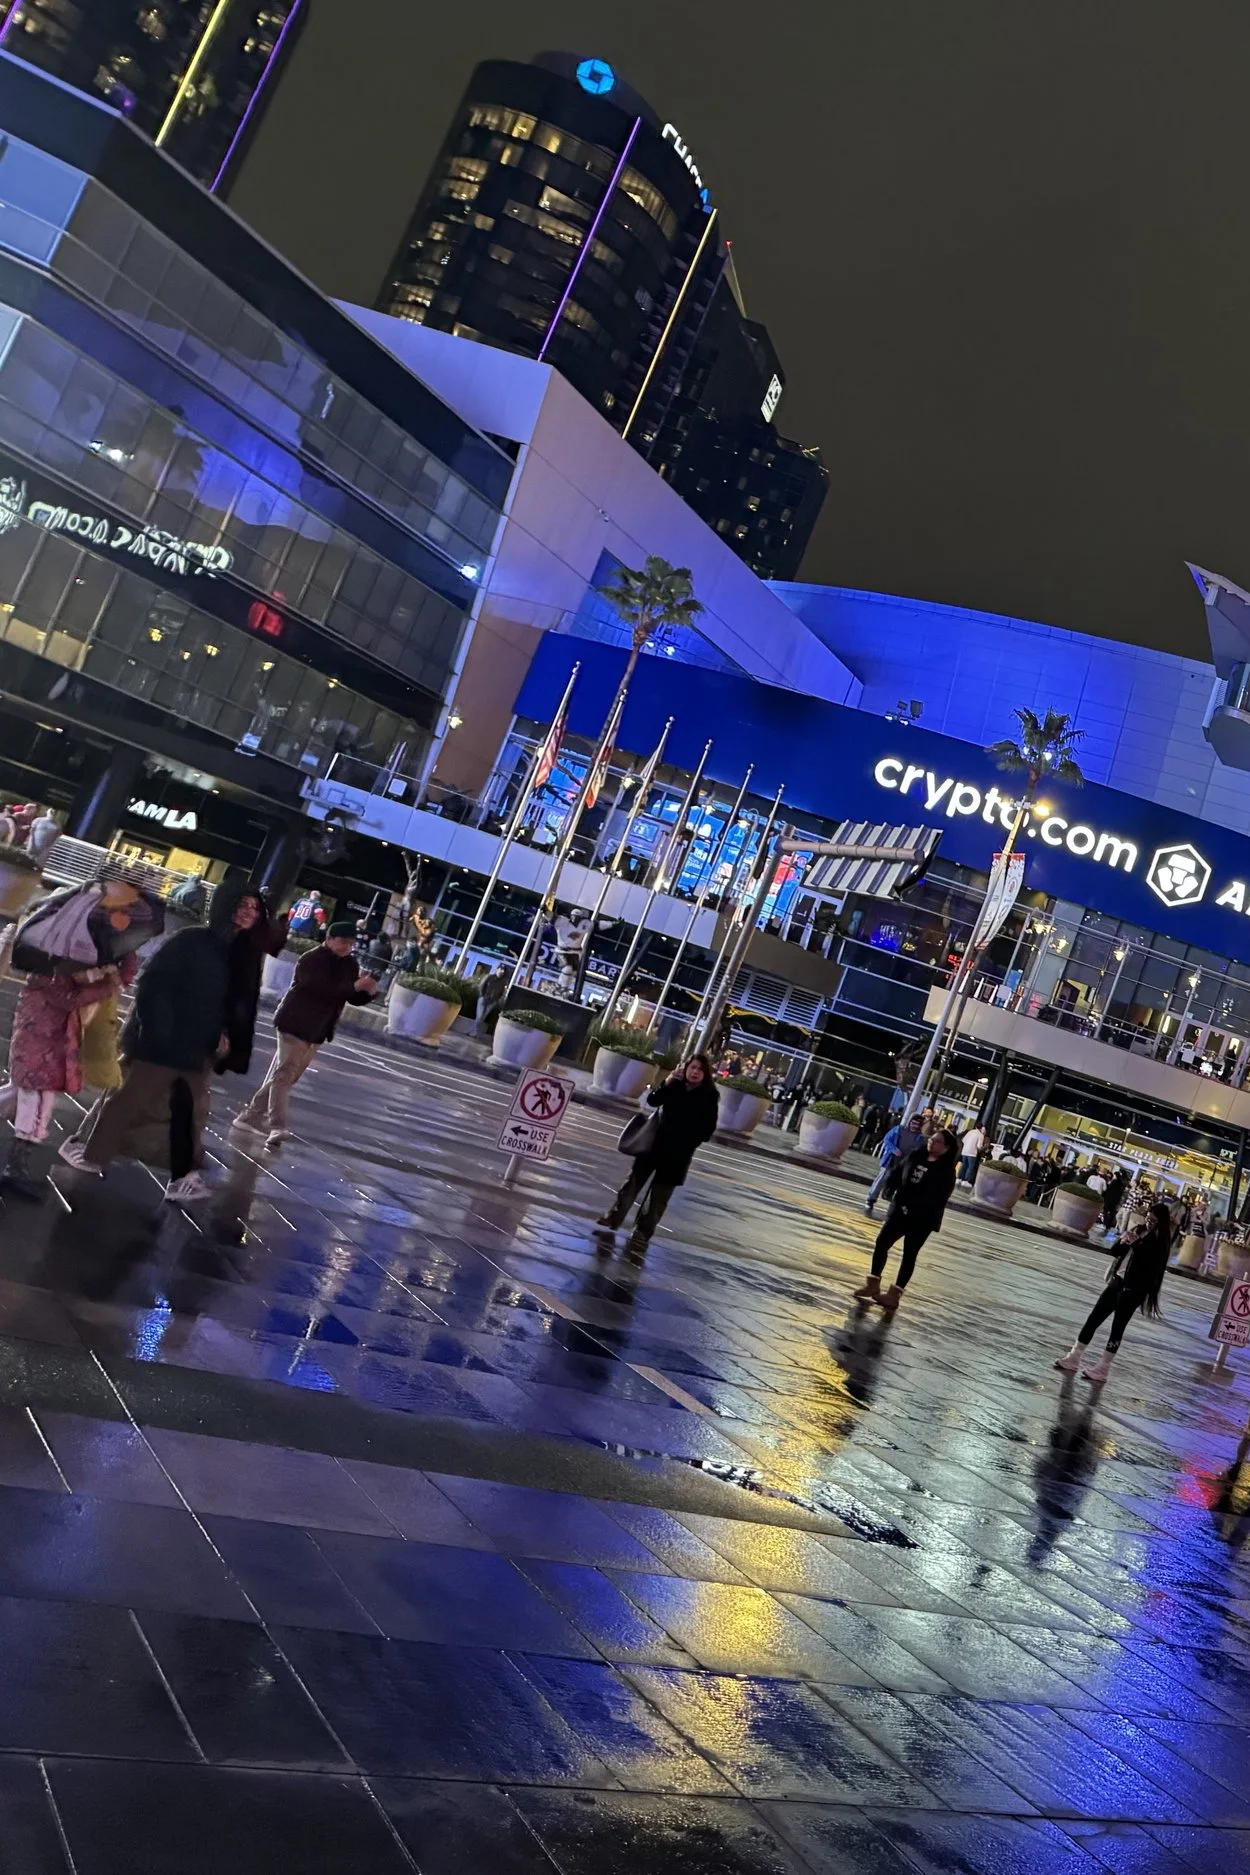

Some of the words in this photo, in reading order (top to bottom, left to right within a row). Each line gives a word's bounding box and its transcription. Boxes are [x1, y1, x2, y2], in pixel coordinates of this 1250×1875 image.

[873, 757, 1138, 873] crypto.com
[586, 961, 617, 977] BAR
[530, 1129, 550, 1143] USE
[501, 1135, 548, 1156] CROSSWALK
